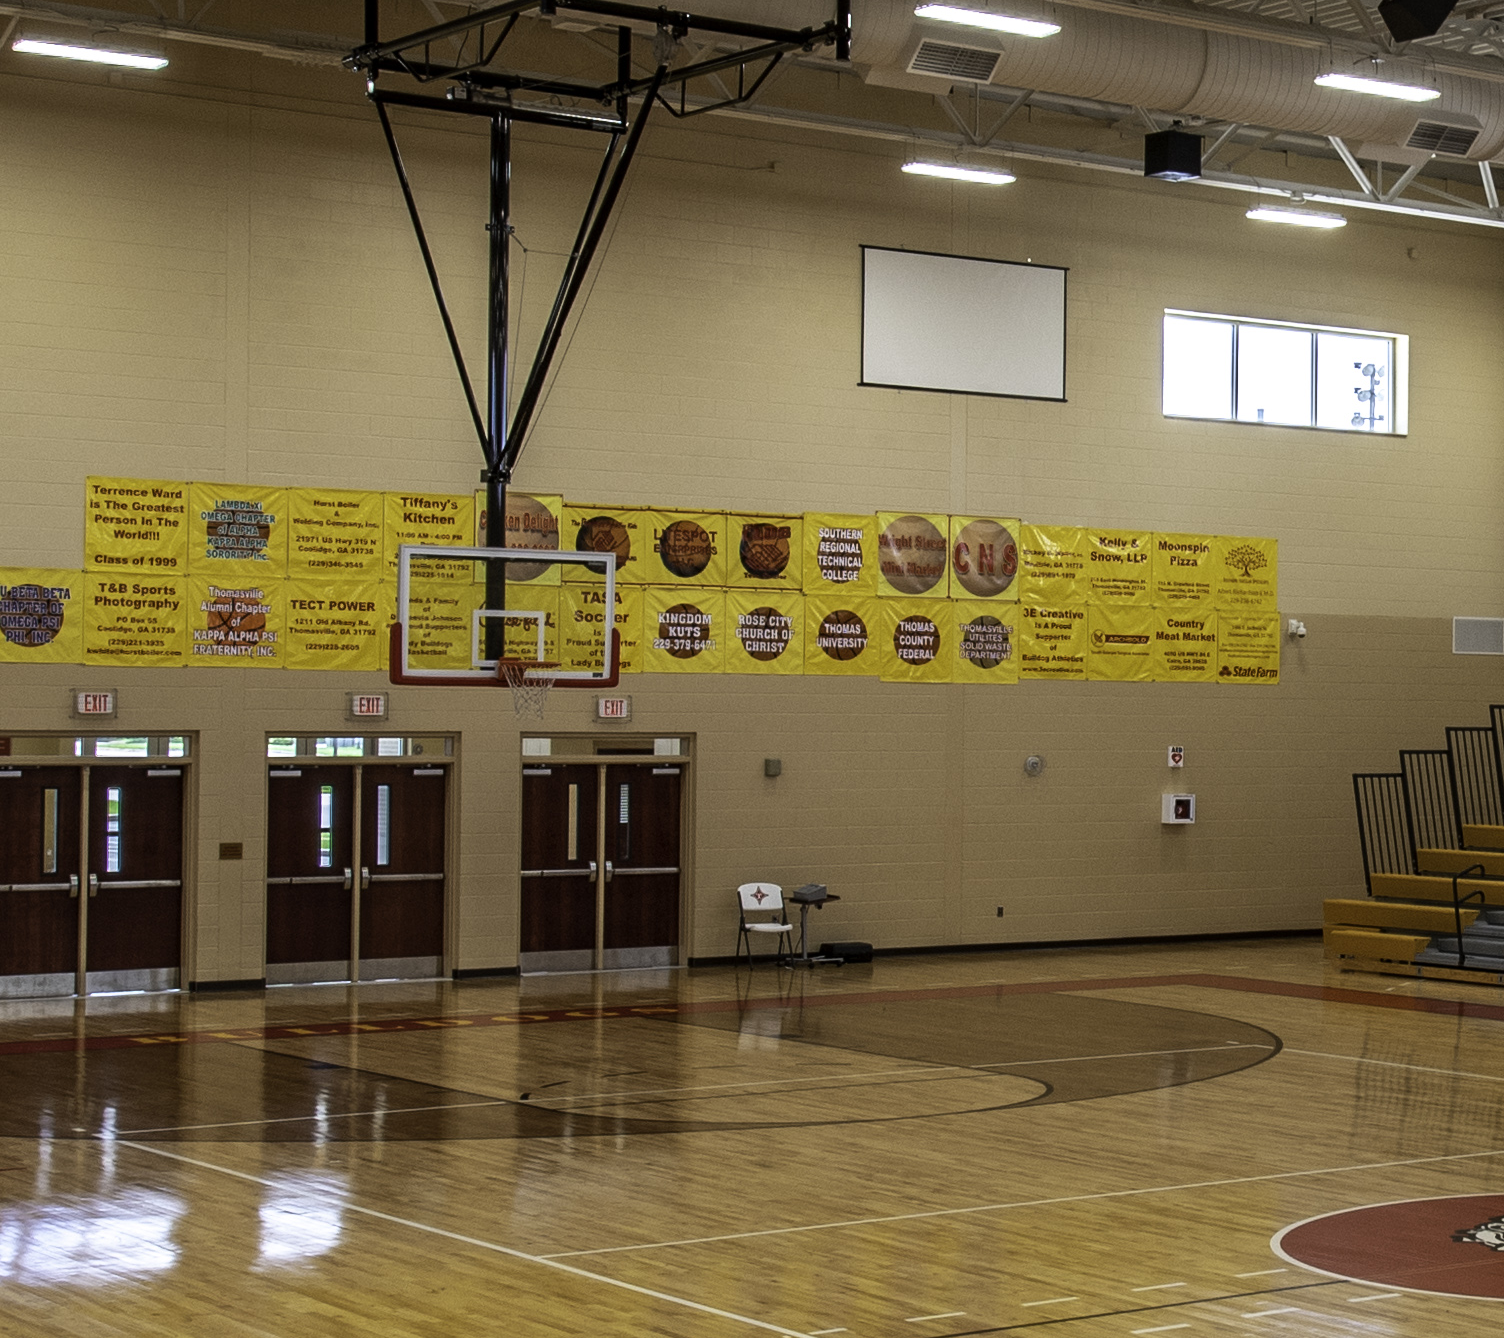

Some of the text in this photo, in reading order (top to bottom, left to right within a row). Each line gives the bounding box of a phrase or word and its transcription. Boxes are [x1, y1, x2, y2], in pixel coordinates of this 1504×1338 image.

[93, 485, 182, 499] Terrence Ward
[105, 501, 128, 510] The
[132, 502, 184, 513] Greatest
[400, 497, 458, 511] Tiffany's
[95, 515, 179, 527] Person In The
[403, 513, 455, 525] Kitchen
[113, 530, 160, 541] World!!!
[819, 528, 862, 539] SOUTHERN
[820, 542, 860, 554] REGIONAL
[1099, 537, 1139, 550] Kelly &
[1158, 541, 1209, 553] Moonspin
[95, 555, 177, 567] Class of 1999
[818, 556, 862, 568] TECHNICAL
[954, 542, 1018, 576] C N S
[1127, 553, 1147, 563] LLP
[1170, 556, 1198, 566] Pizza
[822, 569, 859, 581] COLLEGE
[11, 586, 39, 598] BETA
[43, 587, 71, 600] BETA
[98, 583, 176, 596] T&B Sports
[209, 587, 264, 599] Thomasville
[51, 602, 64, 614] OF
[94, 596, 179, 611] Photography
[201, 601, 271, 614] Alumni Chapter
[291, 600, 375, 611] TECT POWER
[0, 616, 60, 628] OMEGA PSI
[231, 617, 241, 626] of
[658, 612, 712, 625] KINGDOM
[738, 615, 793, 627] ROSE CITY
[1167, 619, 1205, 630] Country
[669, 626, 701, 637] KUTS
[824, 624, 861, 634] THOMAS
[900, 621, 935, 632] THOMAS
[6, 630, 54, 644] PHI, INC.
[194, 630, 277, 642] KAPPA ALPHA PSI
[735, 628, 795, 640] CHURCH OF
[1156, 631, 1215, 642] Meat Market
[746, 641, 785, 653] CHRIST
[816, 638, 868, 648] UNIVERSITY
[900, 636, 934, 646] COUNTY
[257, 646, 276, 657] INC.
[898, 650, 935, 659] FEDERAL
[84, 694, 109, 712] EXIT
[358, 697, 381, 714] EXIT
[603, 700, 624, 716] EXIT
